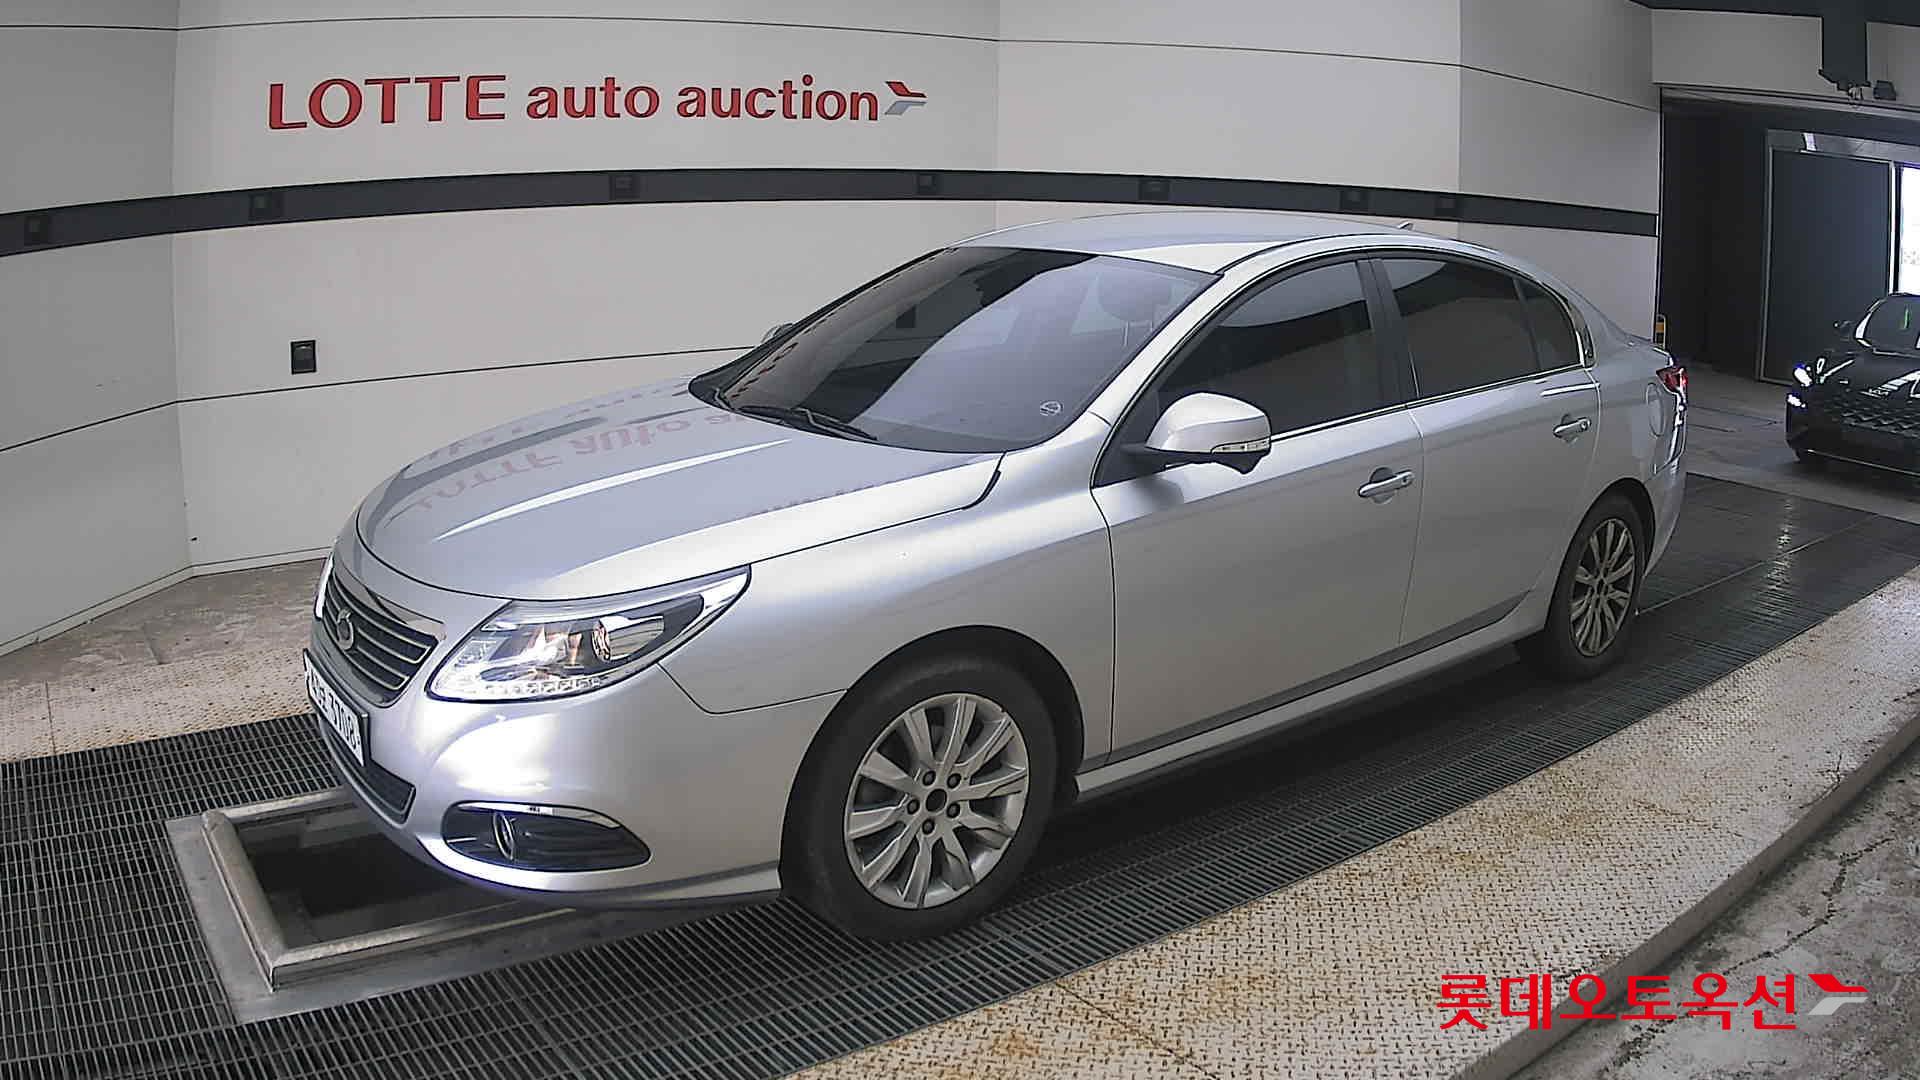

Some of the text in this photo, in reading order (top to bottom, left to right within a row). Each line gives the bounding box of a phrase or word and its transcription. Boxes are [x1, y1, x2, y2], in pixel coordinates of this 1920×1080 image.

[269, 75, 879, 129] LOTTE auto auction
